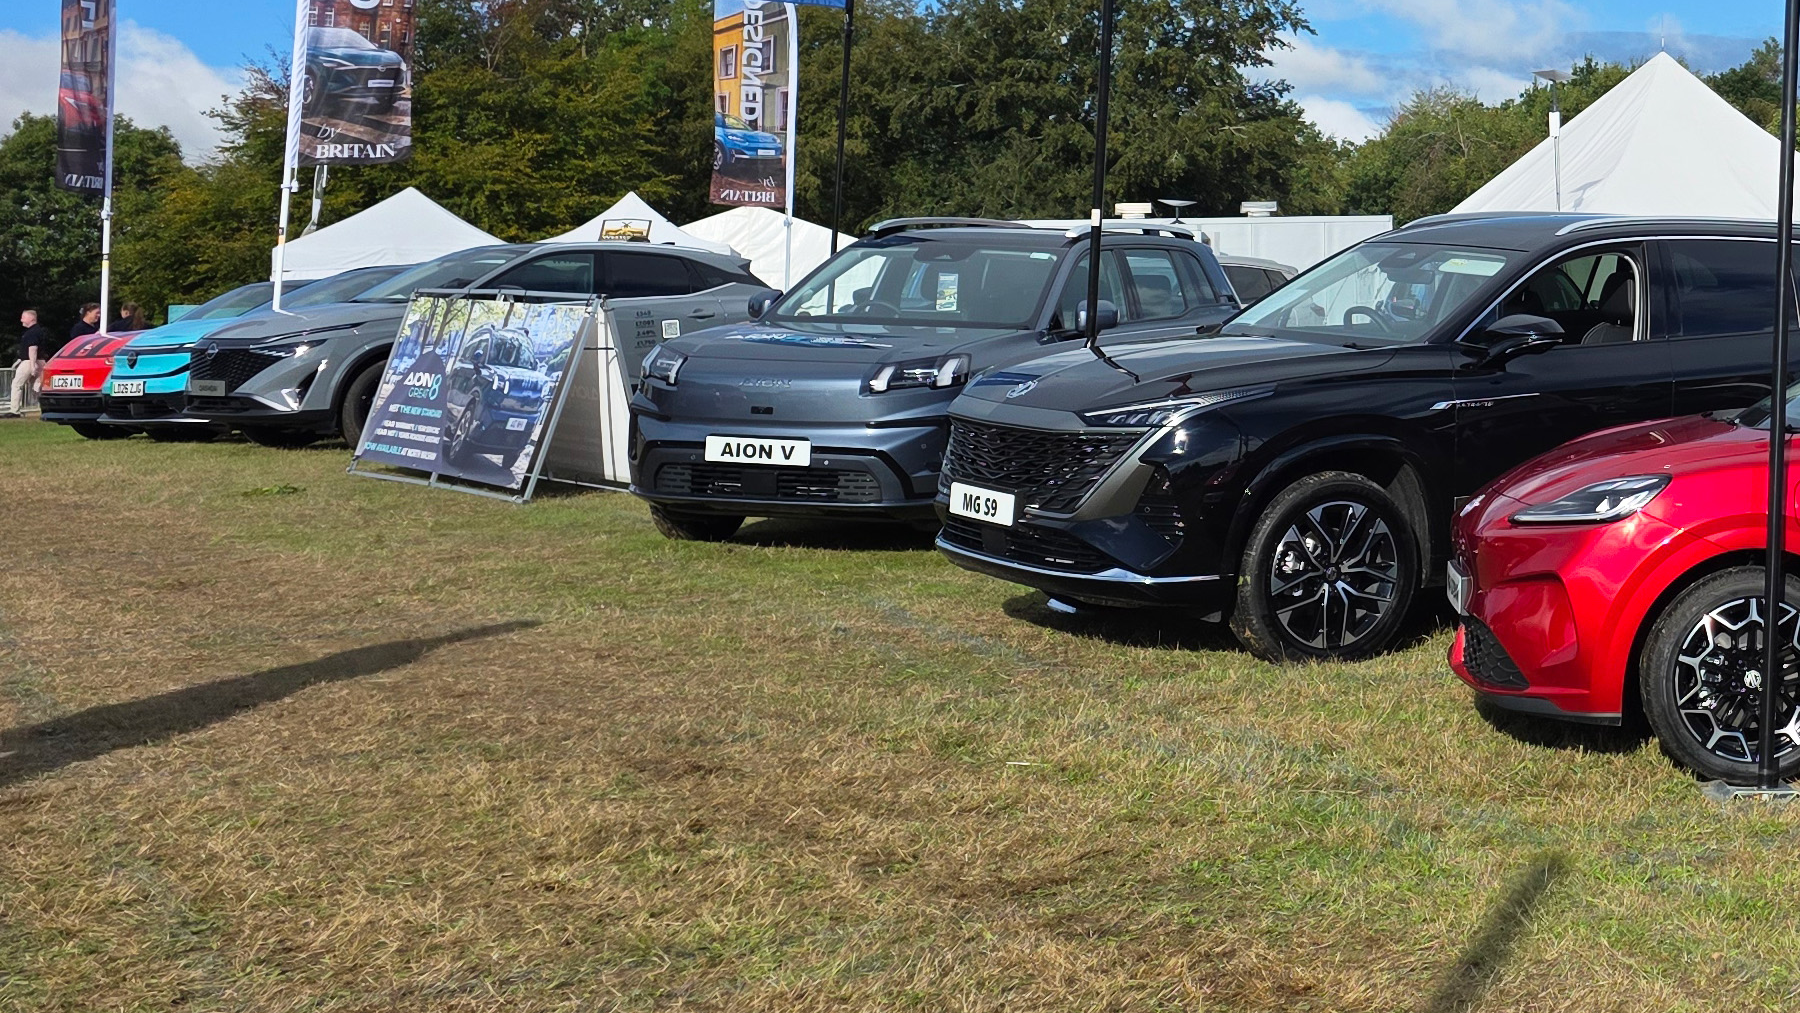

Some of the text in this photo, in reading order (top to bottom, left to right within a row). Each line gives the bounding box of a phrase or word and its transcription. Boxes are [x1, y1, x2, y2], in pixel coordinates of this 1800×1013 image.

[316, 123, 342, 143] by
[315, 142, 396, 160] BRITAIN
[720, 442, 796, 461] AION V
[962, 492, 998, 518] MG S9
